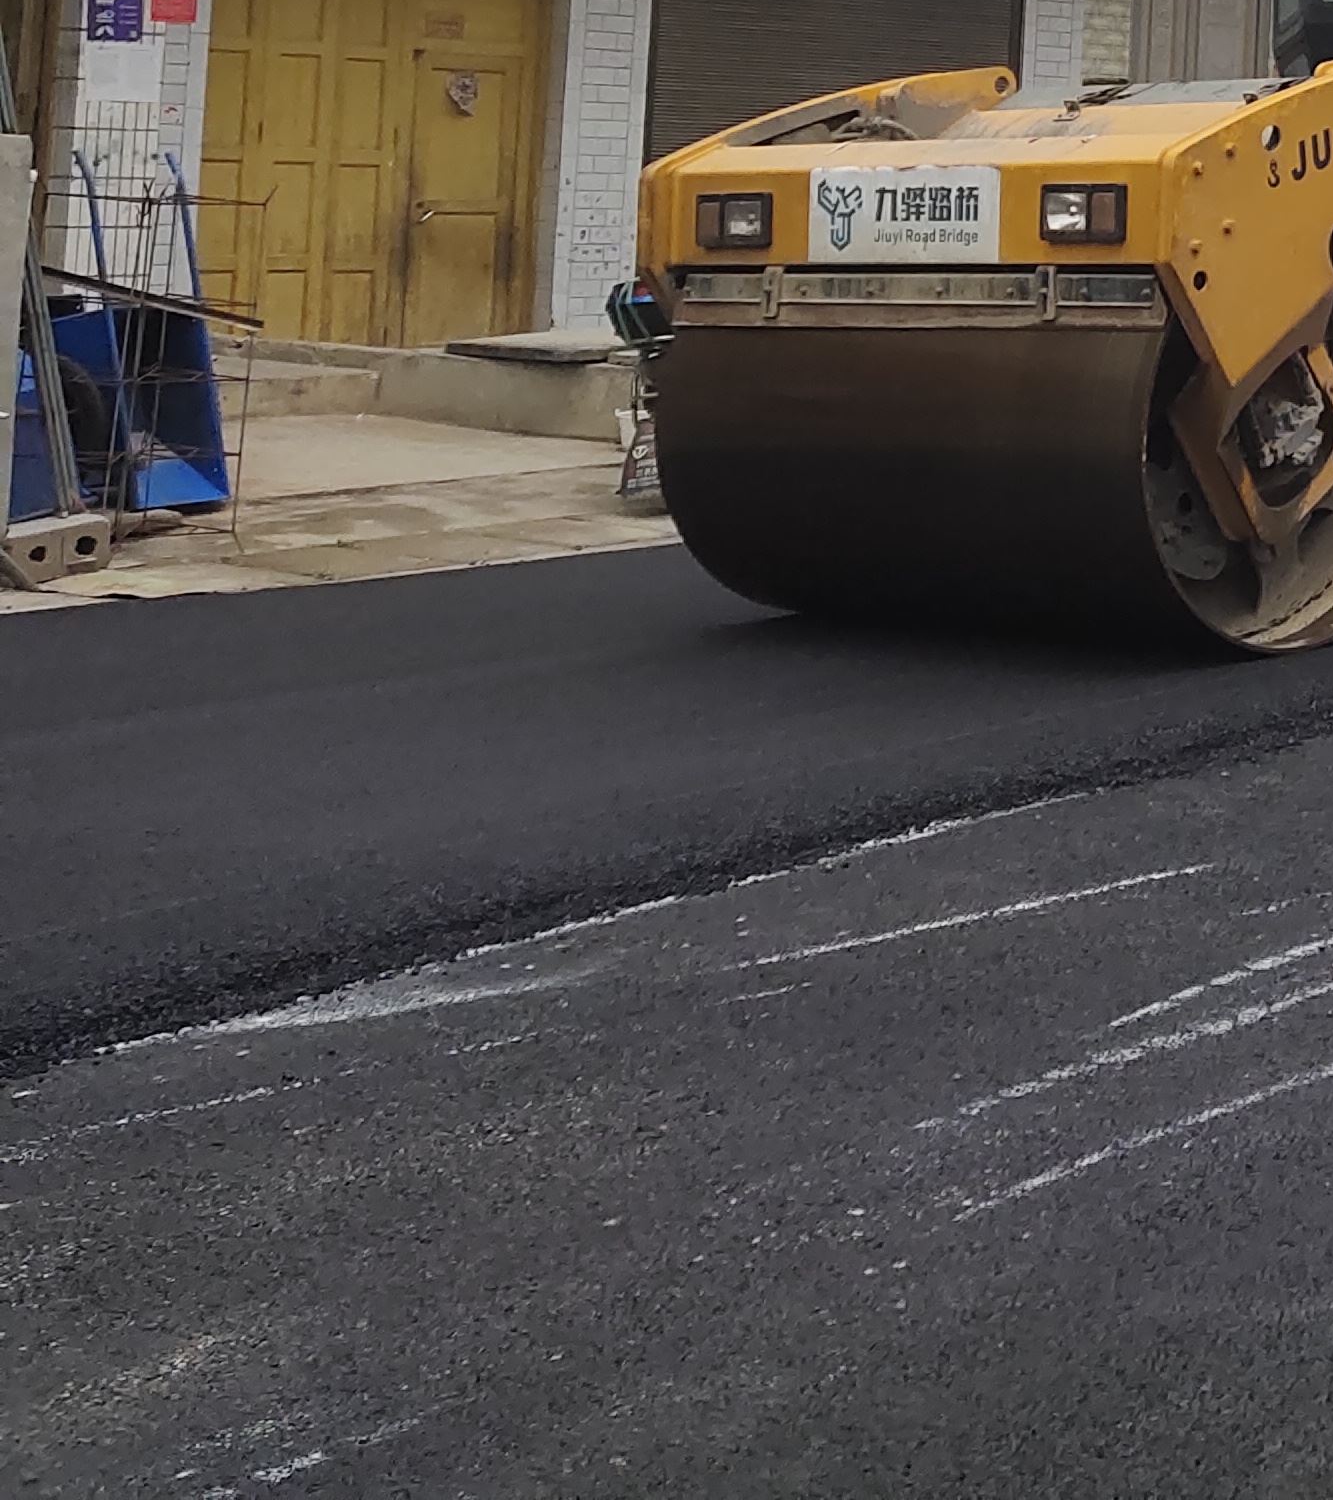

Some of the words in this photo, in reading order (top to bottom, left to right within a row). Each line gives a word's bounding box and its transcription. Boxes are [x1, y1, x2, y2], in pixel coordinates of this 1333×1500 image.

[874, 228, 903, 244] Jiuyi
[906, 228, 935, 243] Road
[939, 228, 979, 246] Bridge
